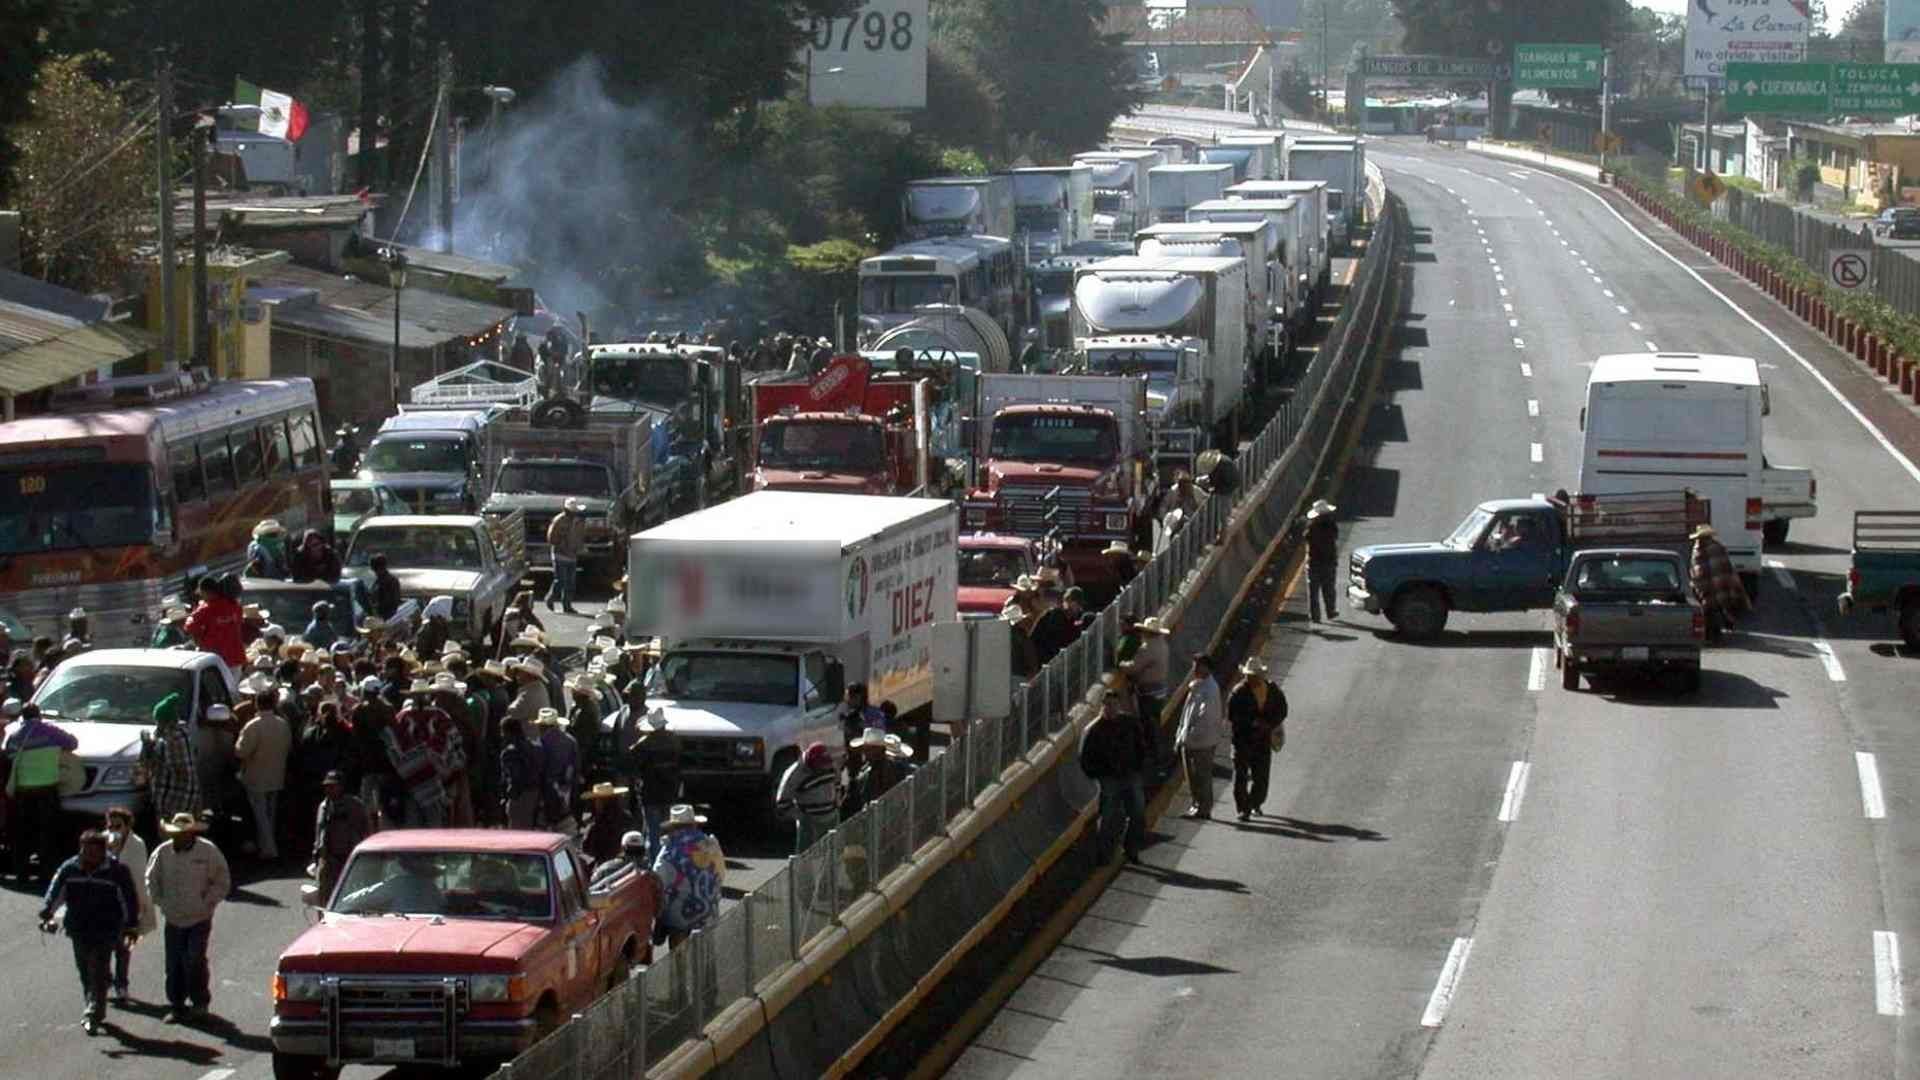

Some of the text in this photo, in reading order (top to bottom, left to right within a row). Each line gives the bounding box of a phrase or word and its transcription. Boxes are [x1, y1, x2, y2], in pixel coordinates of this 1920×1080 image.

[1695, 49, 1713, 60] No
[1716, 48, 1756, 61] olvide
[1520, 69, 1577, 80] ALIMENTOS
[1839, 69, 1901, 80] TOLUCA
[1761, 80, 1827, 96] CUERNAVACA
